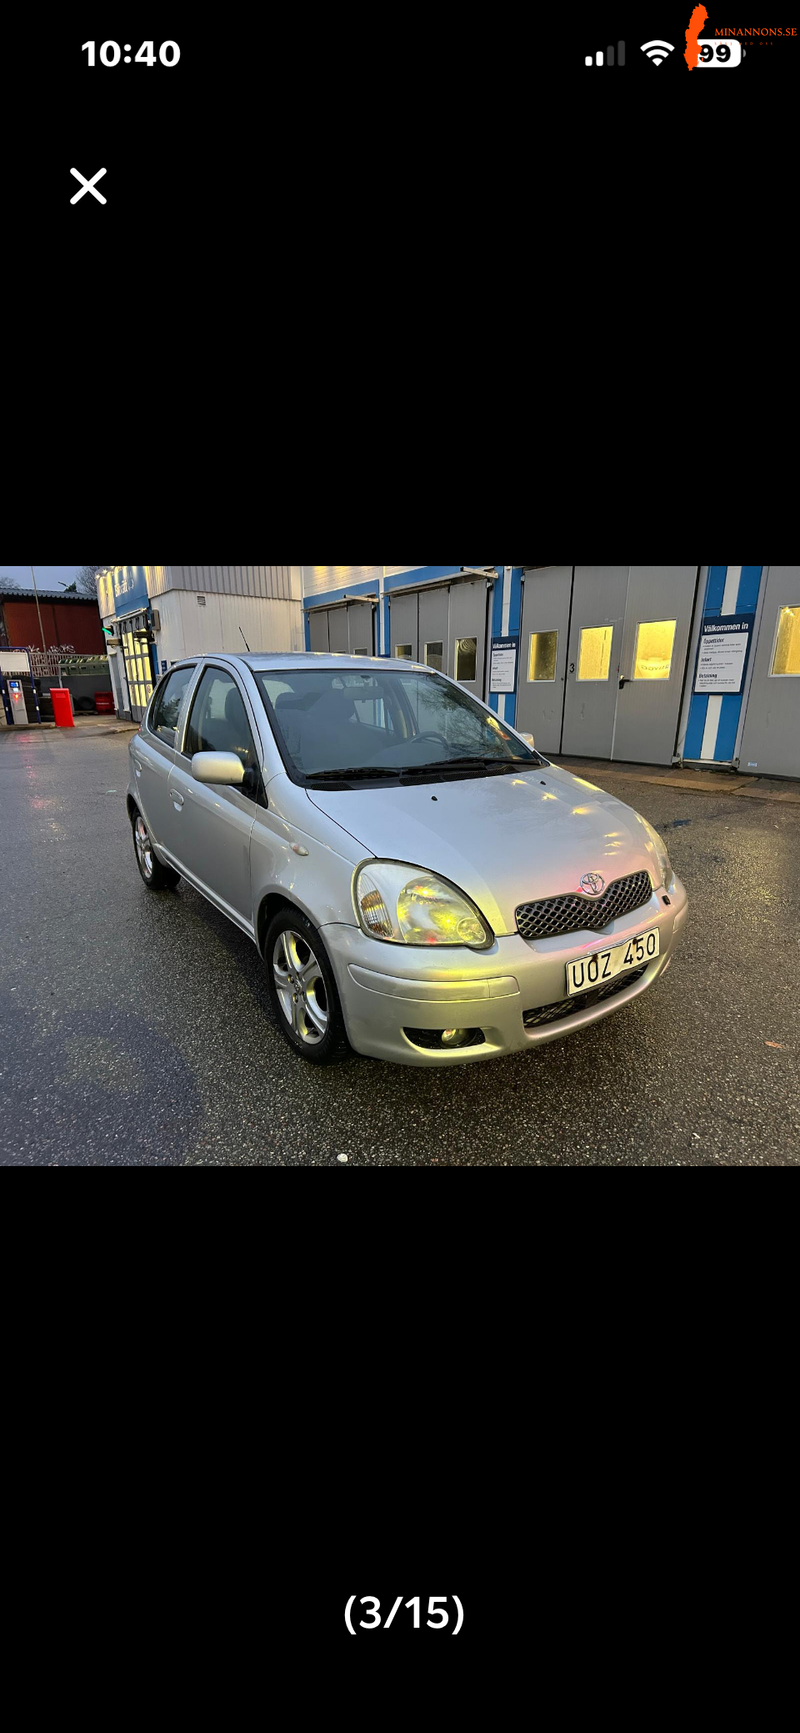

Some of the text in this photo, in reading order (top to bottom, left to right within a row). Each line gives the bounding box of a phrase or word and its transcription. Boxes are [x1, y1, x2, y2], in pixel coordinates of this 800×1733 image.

[703, 624, 740, 632] Välkommen
[569, 663, 575, 673] 3
[573, 933, 655, 987] UOZ 450
